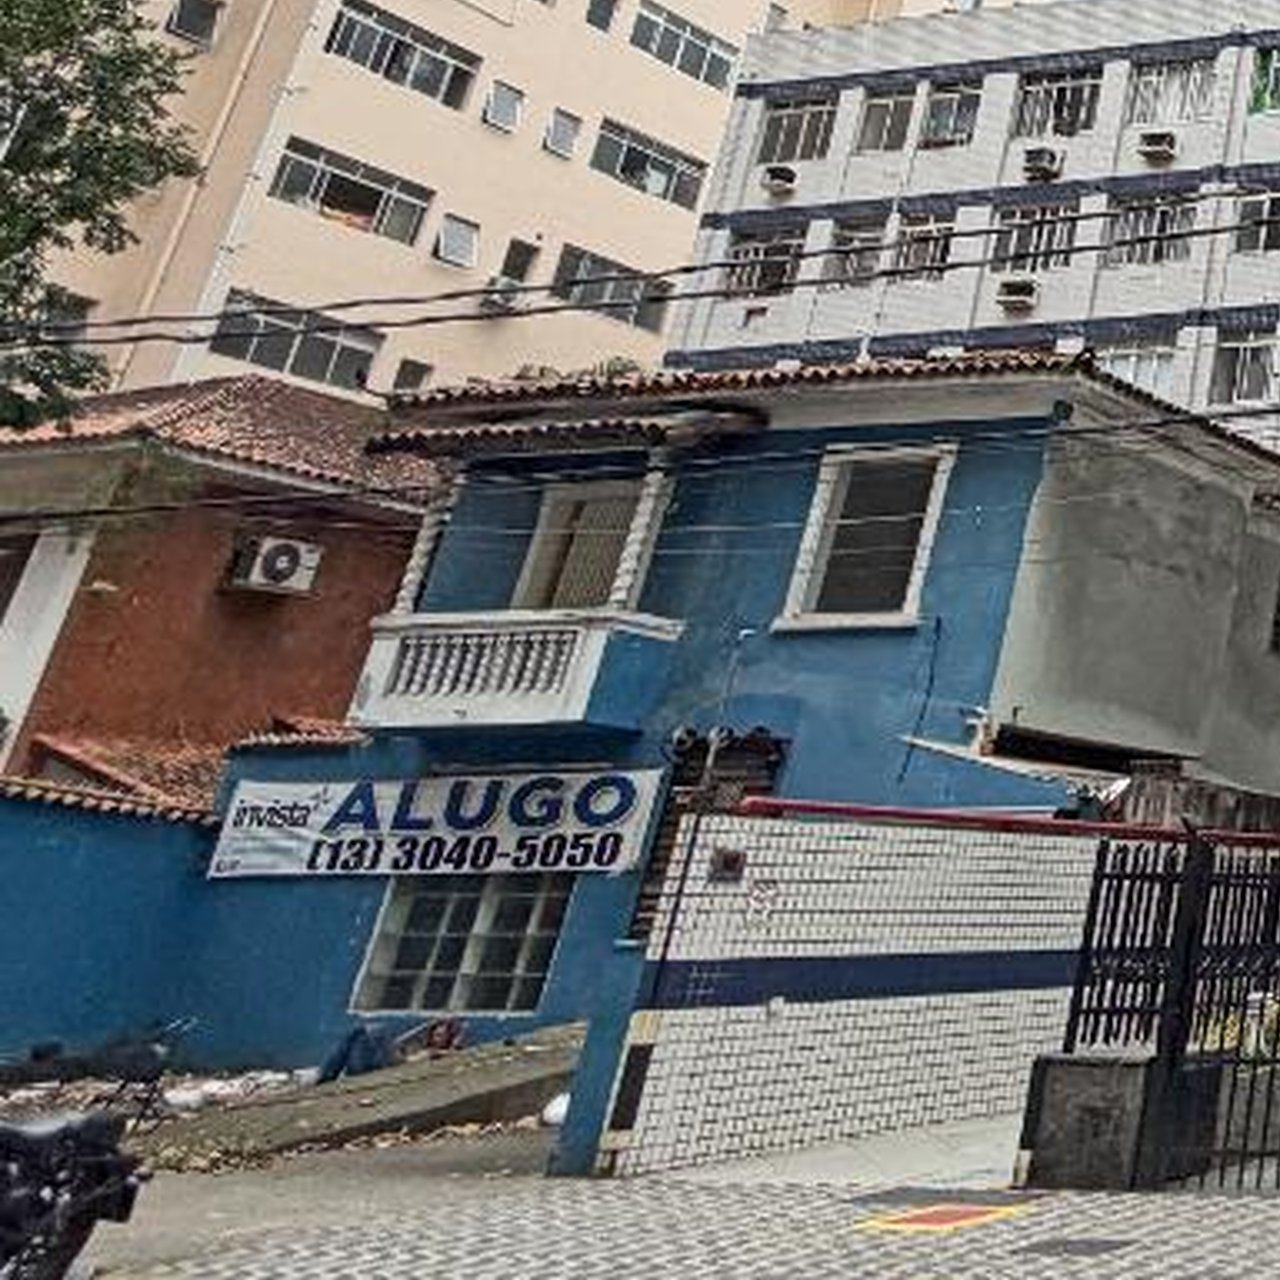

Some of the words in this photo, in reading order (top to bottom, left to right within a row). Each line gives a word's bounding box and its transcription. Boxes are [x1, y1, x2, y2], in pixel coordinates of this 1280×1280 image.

[233, 799, 310, 827] invista
[320, 775, 637, 834] ALUGO
[394, 832, 623, 871] 3040-5050
